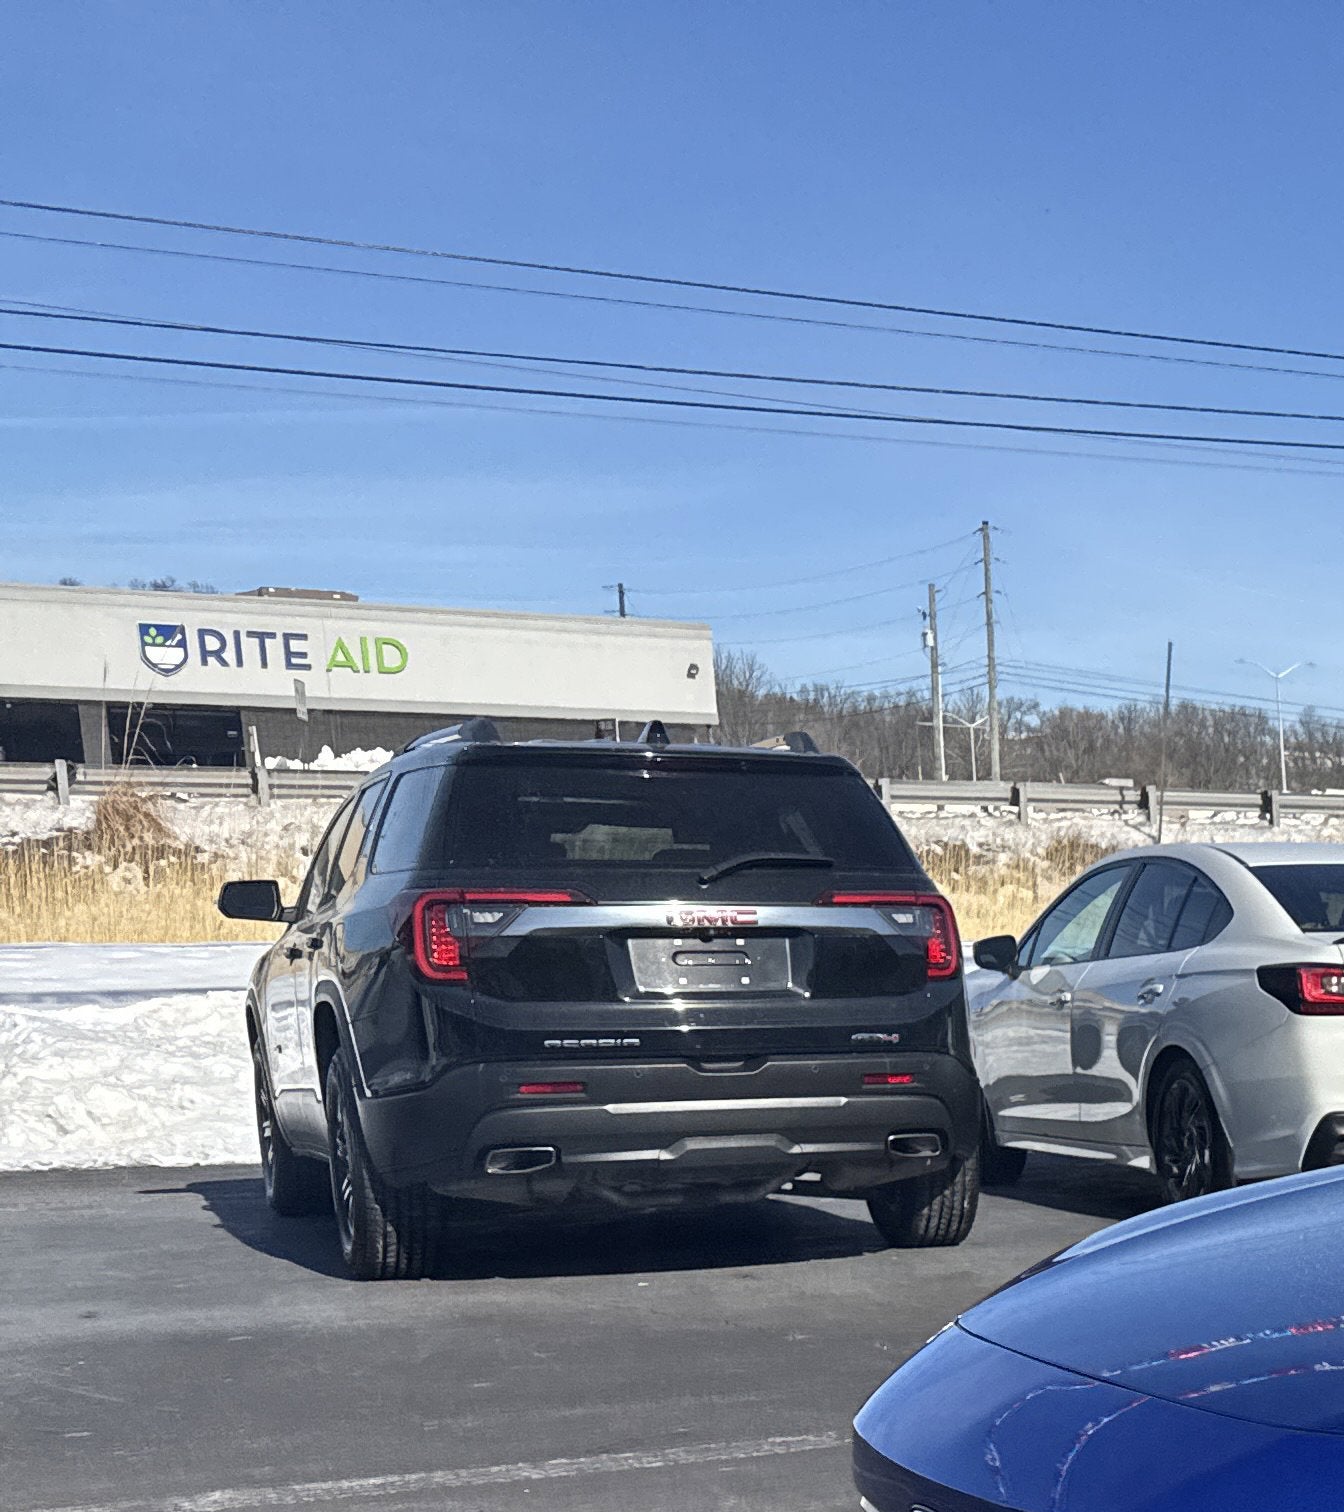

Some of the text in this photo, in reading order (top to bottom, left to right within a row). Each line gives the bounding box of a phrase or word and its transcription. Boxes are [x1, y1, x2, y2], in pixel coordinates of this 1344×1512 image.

[197, 627, 409, 674] RITE AID
[665, 909, 759, 927] GMC
